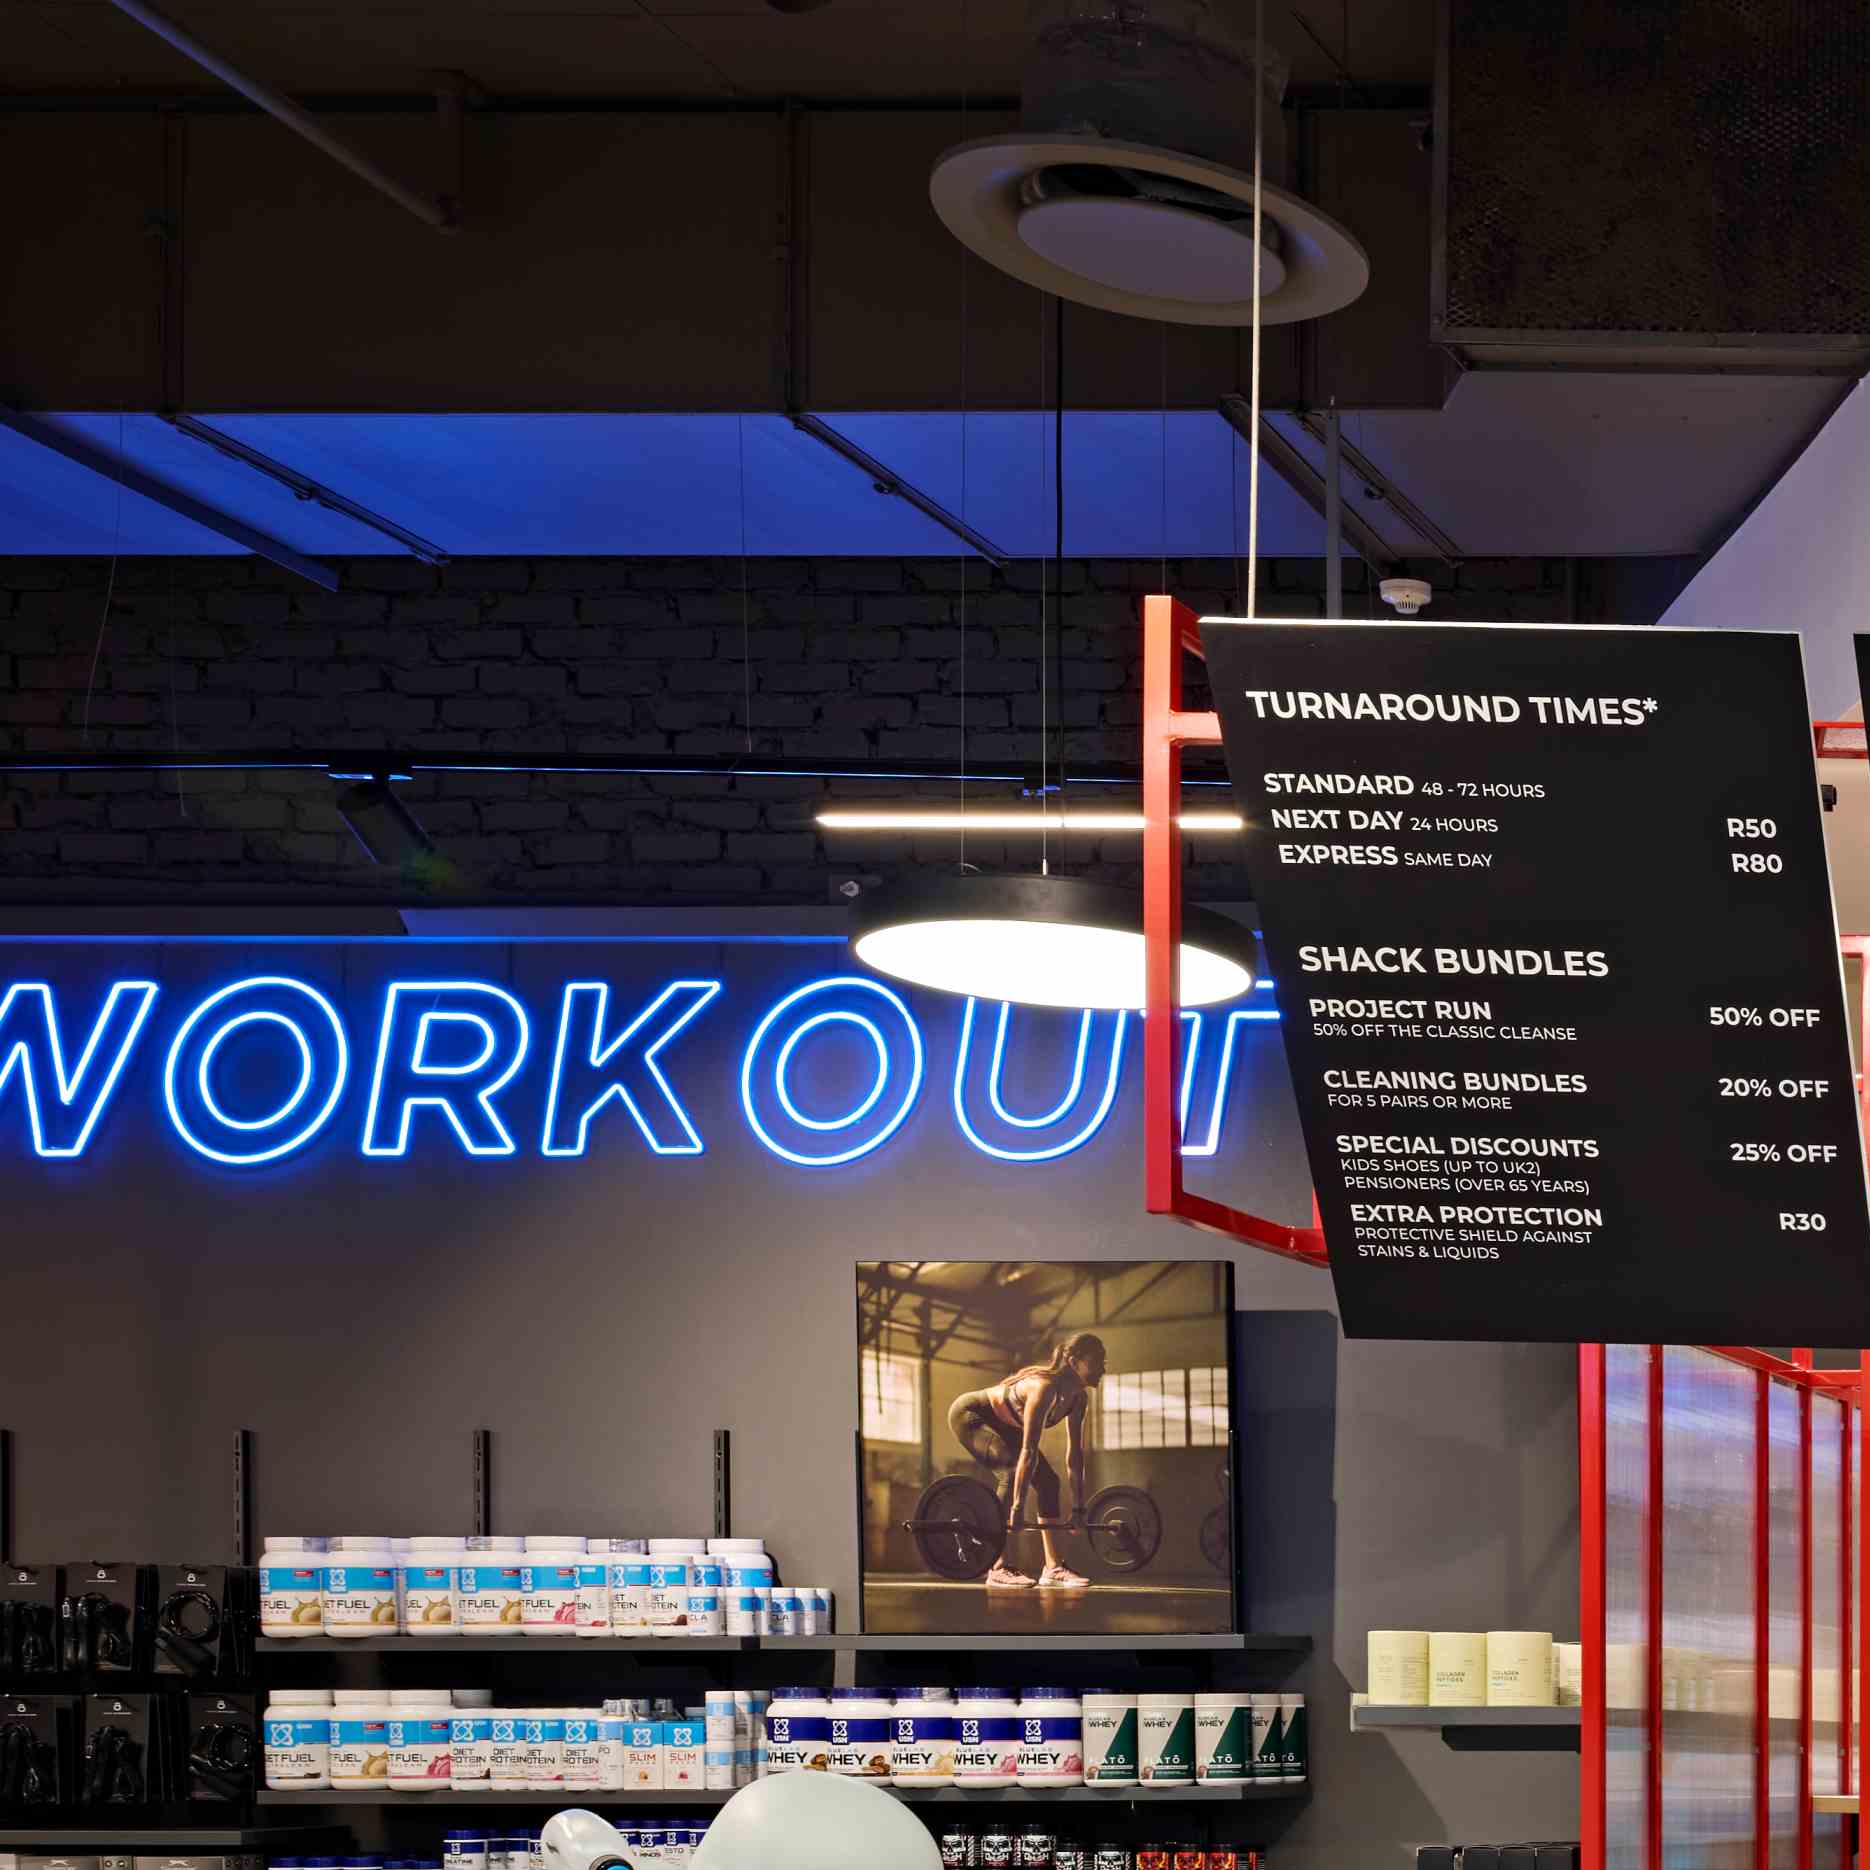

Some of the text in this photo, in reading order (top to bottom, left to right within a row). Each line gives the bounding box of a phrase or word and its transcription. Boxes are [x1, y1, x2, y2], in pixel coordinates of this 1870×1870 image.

[1245, 690, 1521, 723] TURNAROUND
[1263, 772, 1415, 795] STANDARD
[1421, 782, 1444, 796] 48
[1456, 782, 1479, 797] 72
[1481, 783, 1546, 798] HOURS
[1270, 808, 1777, 839] NEXT DAY 24 HOURS R50
[1278, 844, 1783, 874] EXPRESS SAME DAY R80
[1298, 945, 1609, 977] SHACK BUNDLES
[1308, 998, 1821, 1028] PROJECT RUN 50% OFF
[1344, 1176, 1590, 1196] PENSIONERS (OVER 65 YEARS)
[1354, 1227, 1593, 1244] PROTECTIVE SHIELD AGAINST
[1357, 1244, 1500, 1261] STAINS & LIQUIDS
